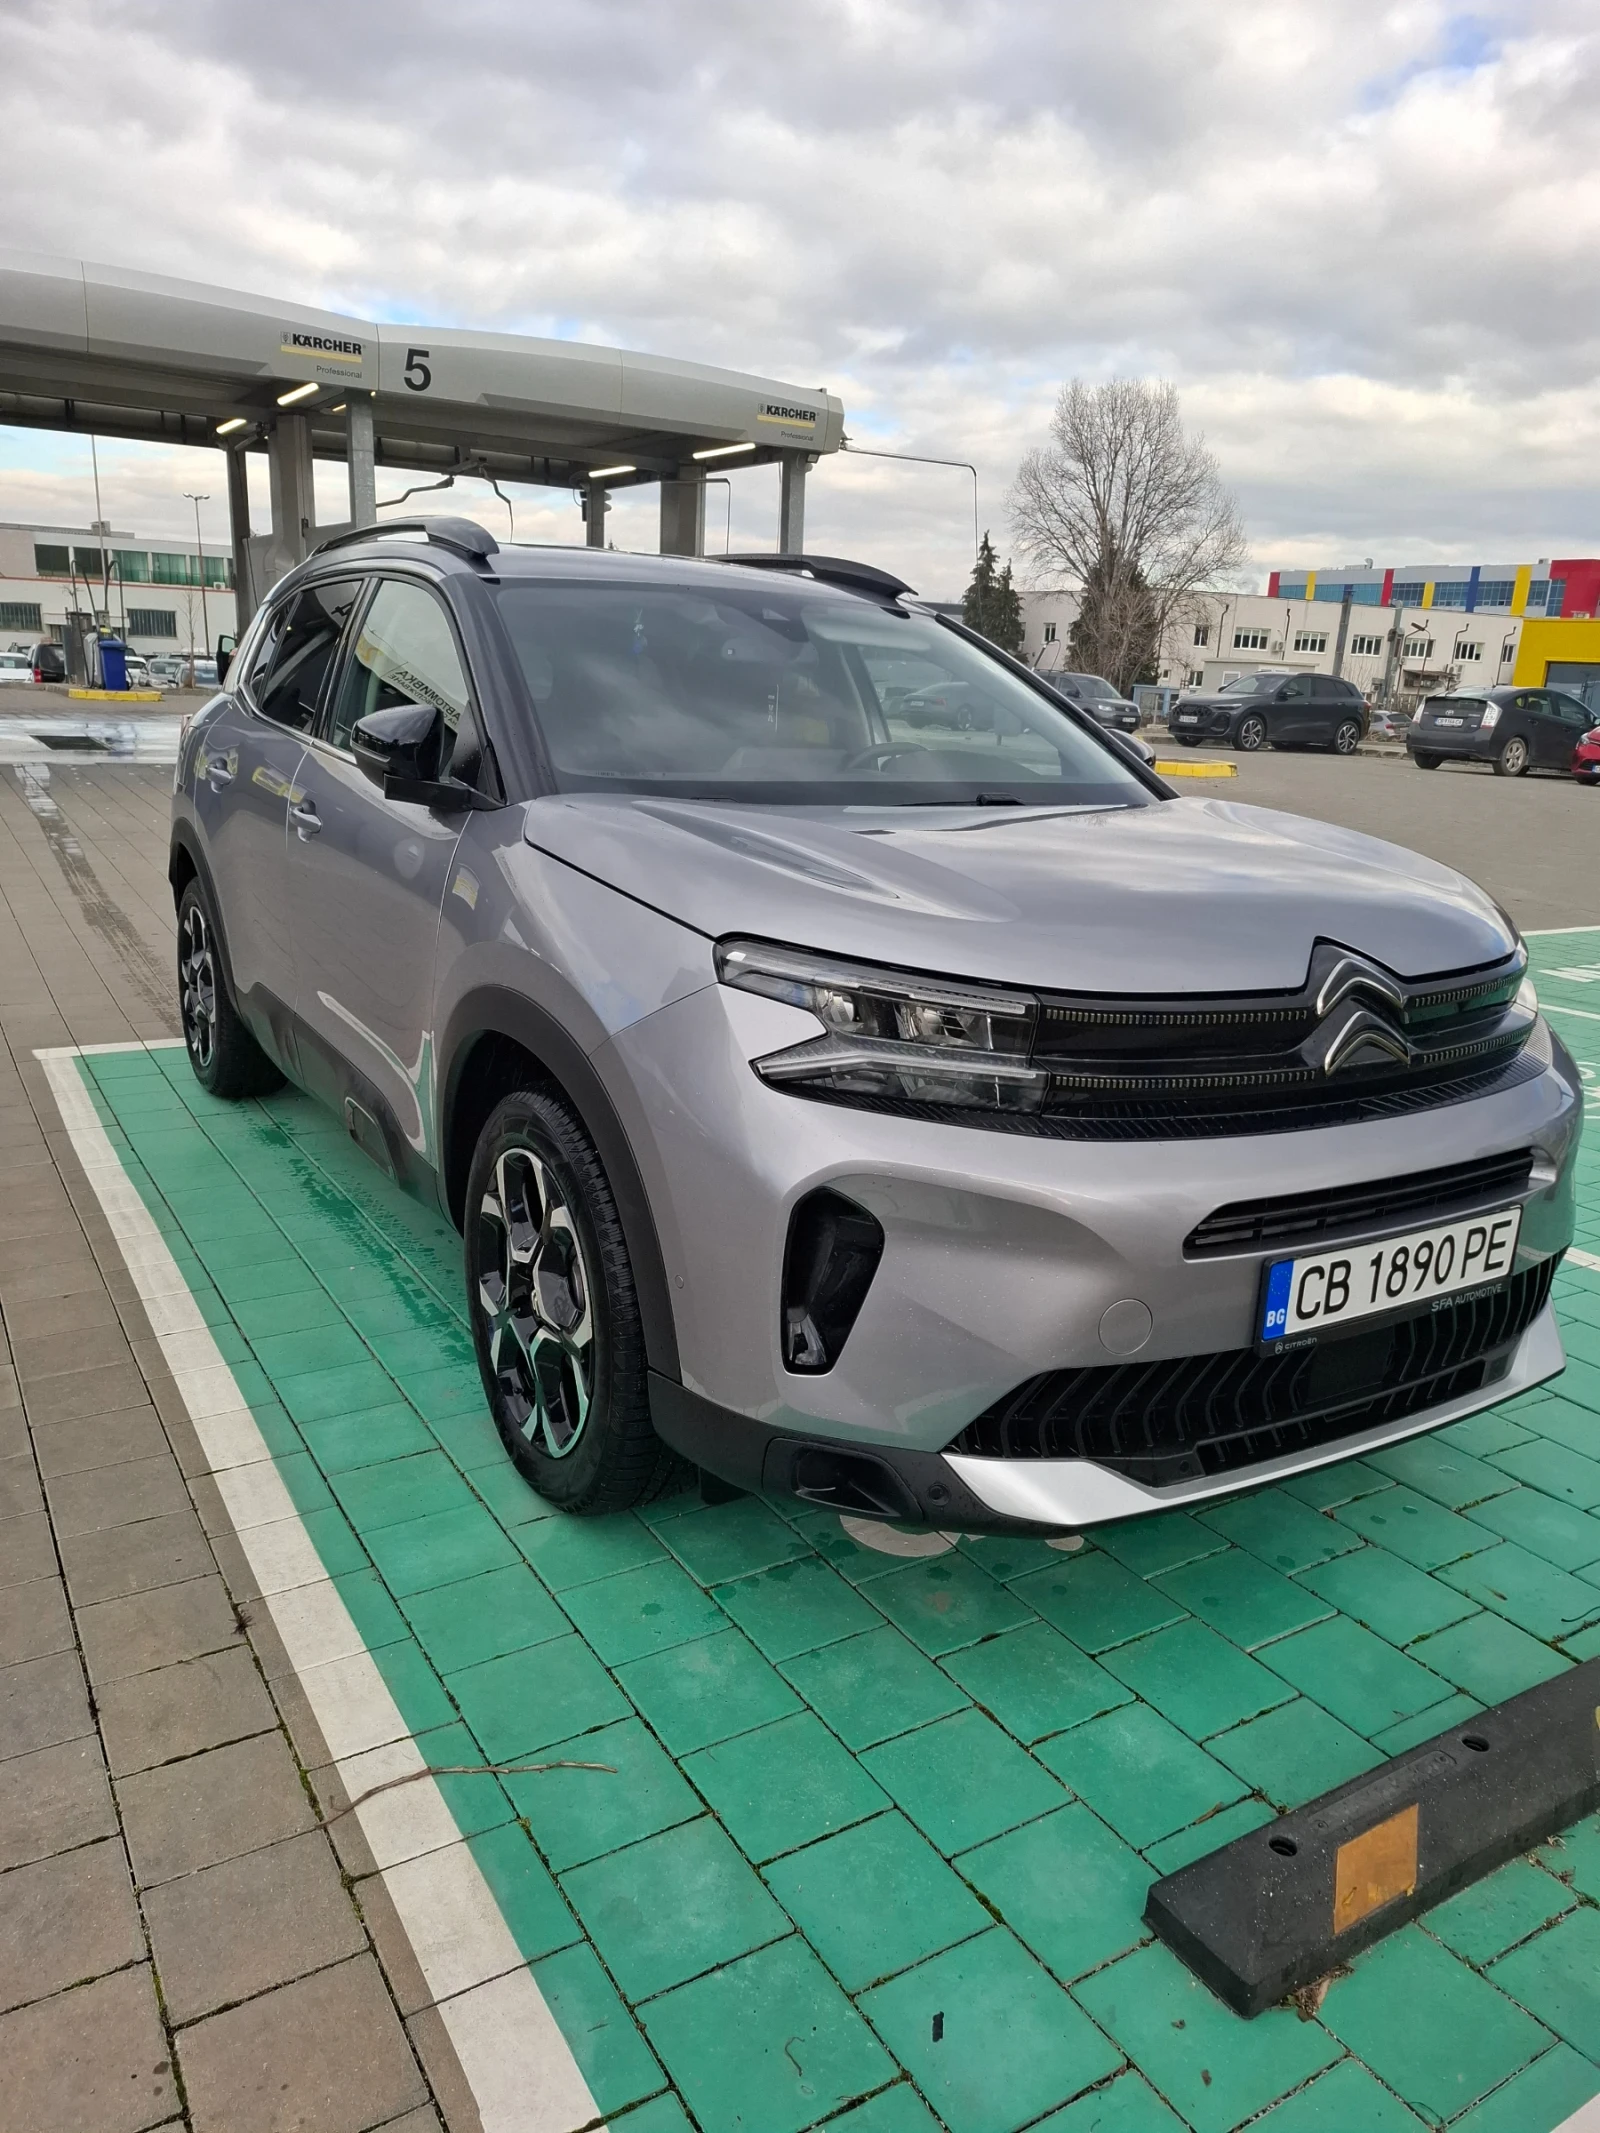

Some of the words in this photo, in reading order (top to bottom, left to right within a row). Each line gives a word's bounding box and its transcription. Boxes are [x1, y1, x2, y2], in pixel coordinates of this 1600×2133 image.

[292, 333, 363, 355] KÄRCHER
[316, 365, 363, 379] Professional
[403, 348, 432, 392] 5
[766, 404, 816, 421] KÄRCHER
[780, 430, 814, 441] Professional
[1295, 1259, 1352, 1320] CB
[1369, 1234, 1455, 1304] 1890
[1459, 1219, 1513, 1279] PE
[1431, 1296, 1453, 1312] SFA
[1454, 1283, 1503, 1306] AUTOMOTIVE
[1266, 1308, 1286, 1328] BG
